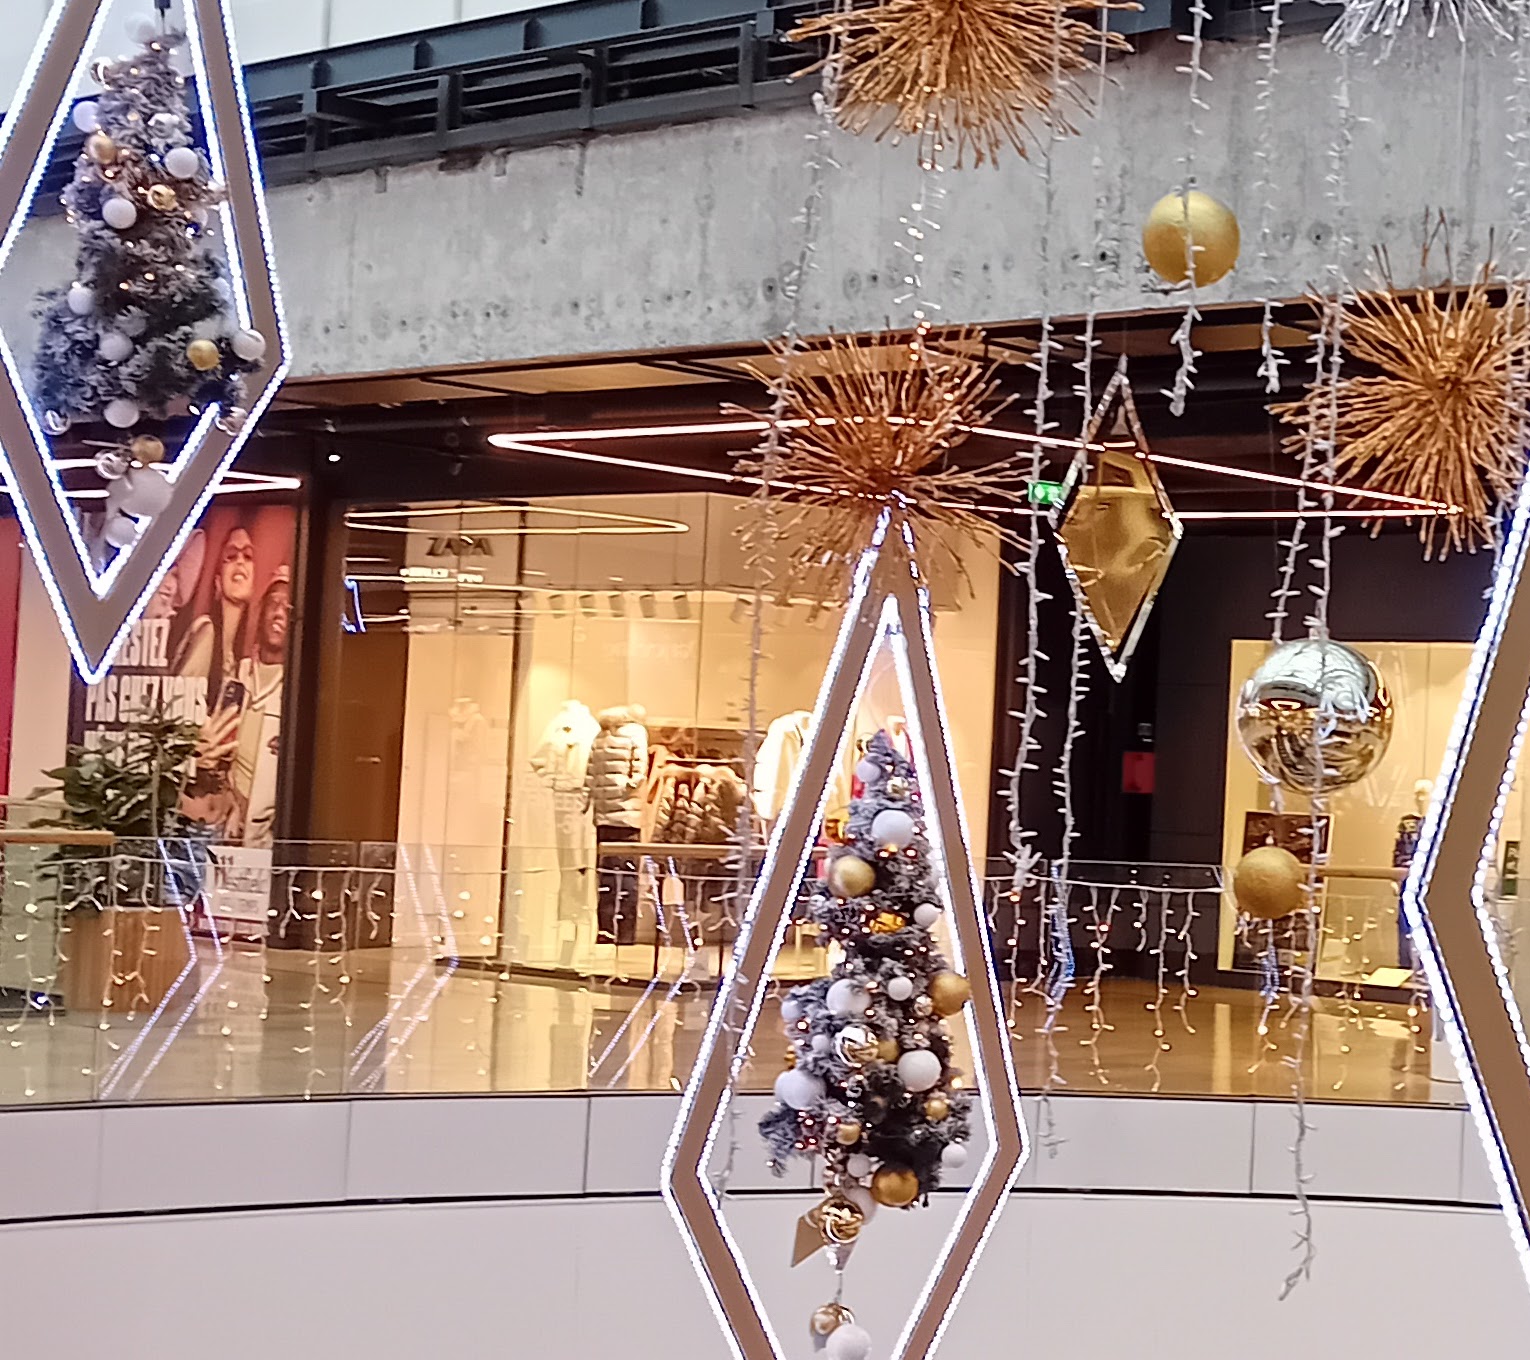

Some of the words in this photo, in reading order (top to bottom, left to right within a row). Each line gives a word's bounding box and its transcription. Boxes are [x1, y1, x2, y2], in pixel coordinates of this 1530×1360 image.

[113, 618, 170, 667] ESTEZ
[85, 677, 117, 722] PAS
[119, 677, 159, 723] CHEZ
[161, 676, 208, 726] VOUS
